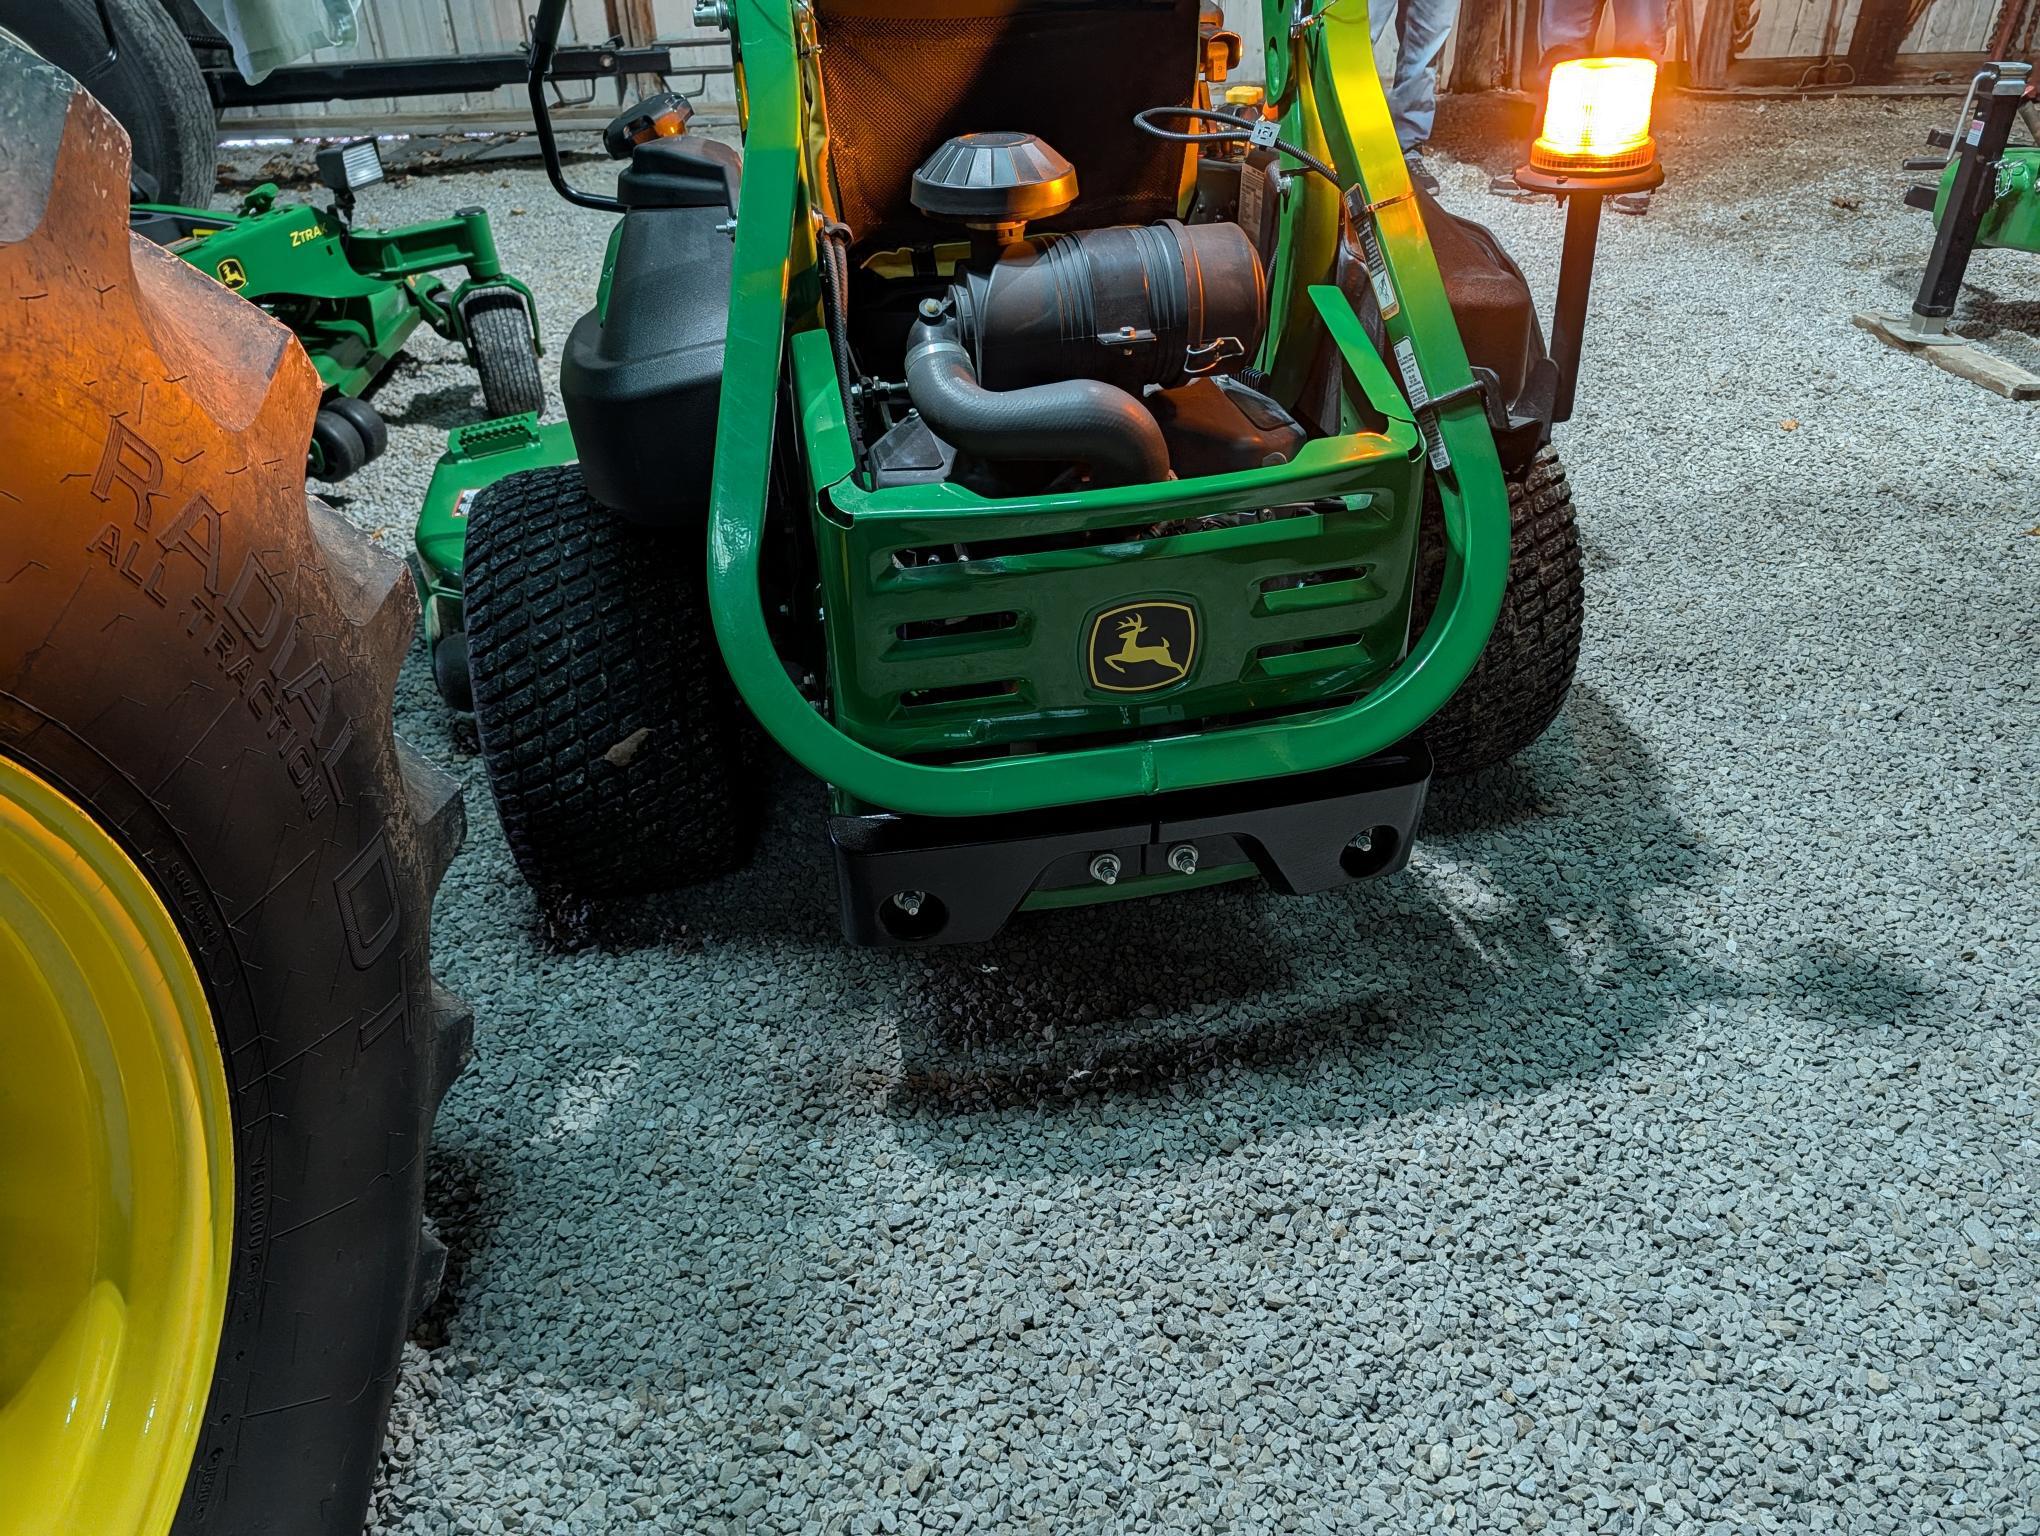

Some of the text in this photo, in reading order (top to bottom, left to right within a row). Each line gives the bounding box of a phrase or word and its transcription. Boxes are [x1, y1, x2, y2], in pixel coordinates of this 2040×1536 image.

[86, 523, 328, 822] ALL TRACTION
[90, 415, 353, 804] RADIAL
